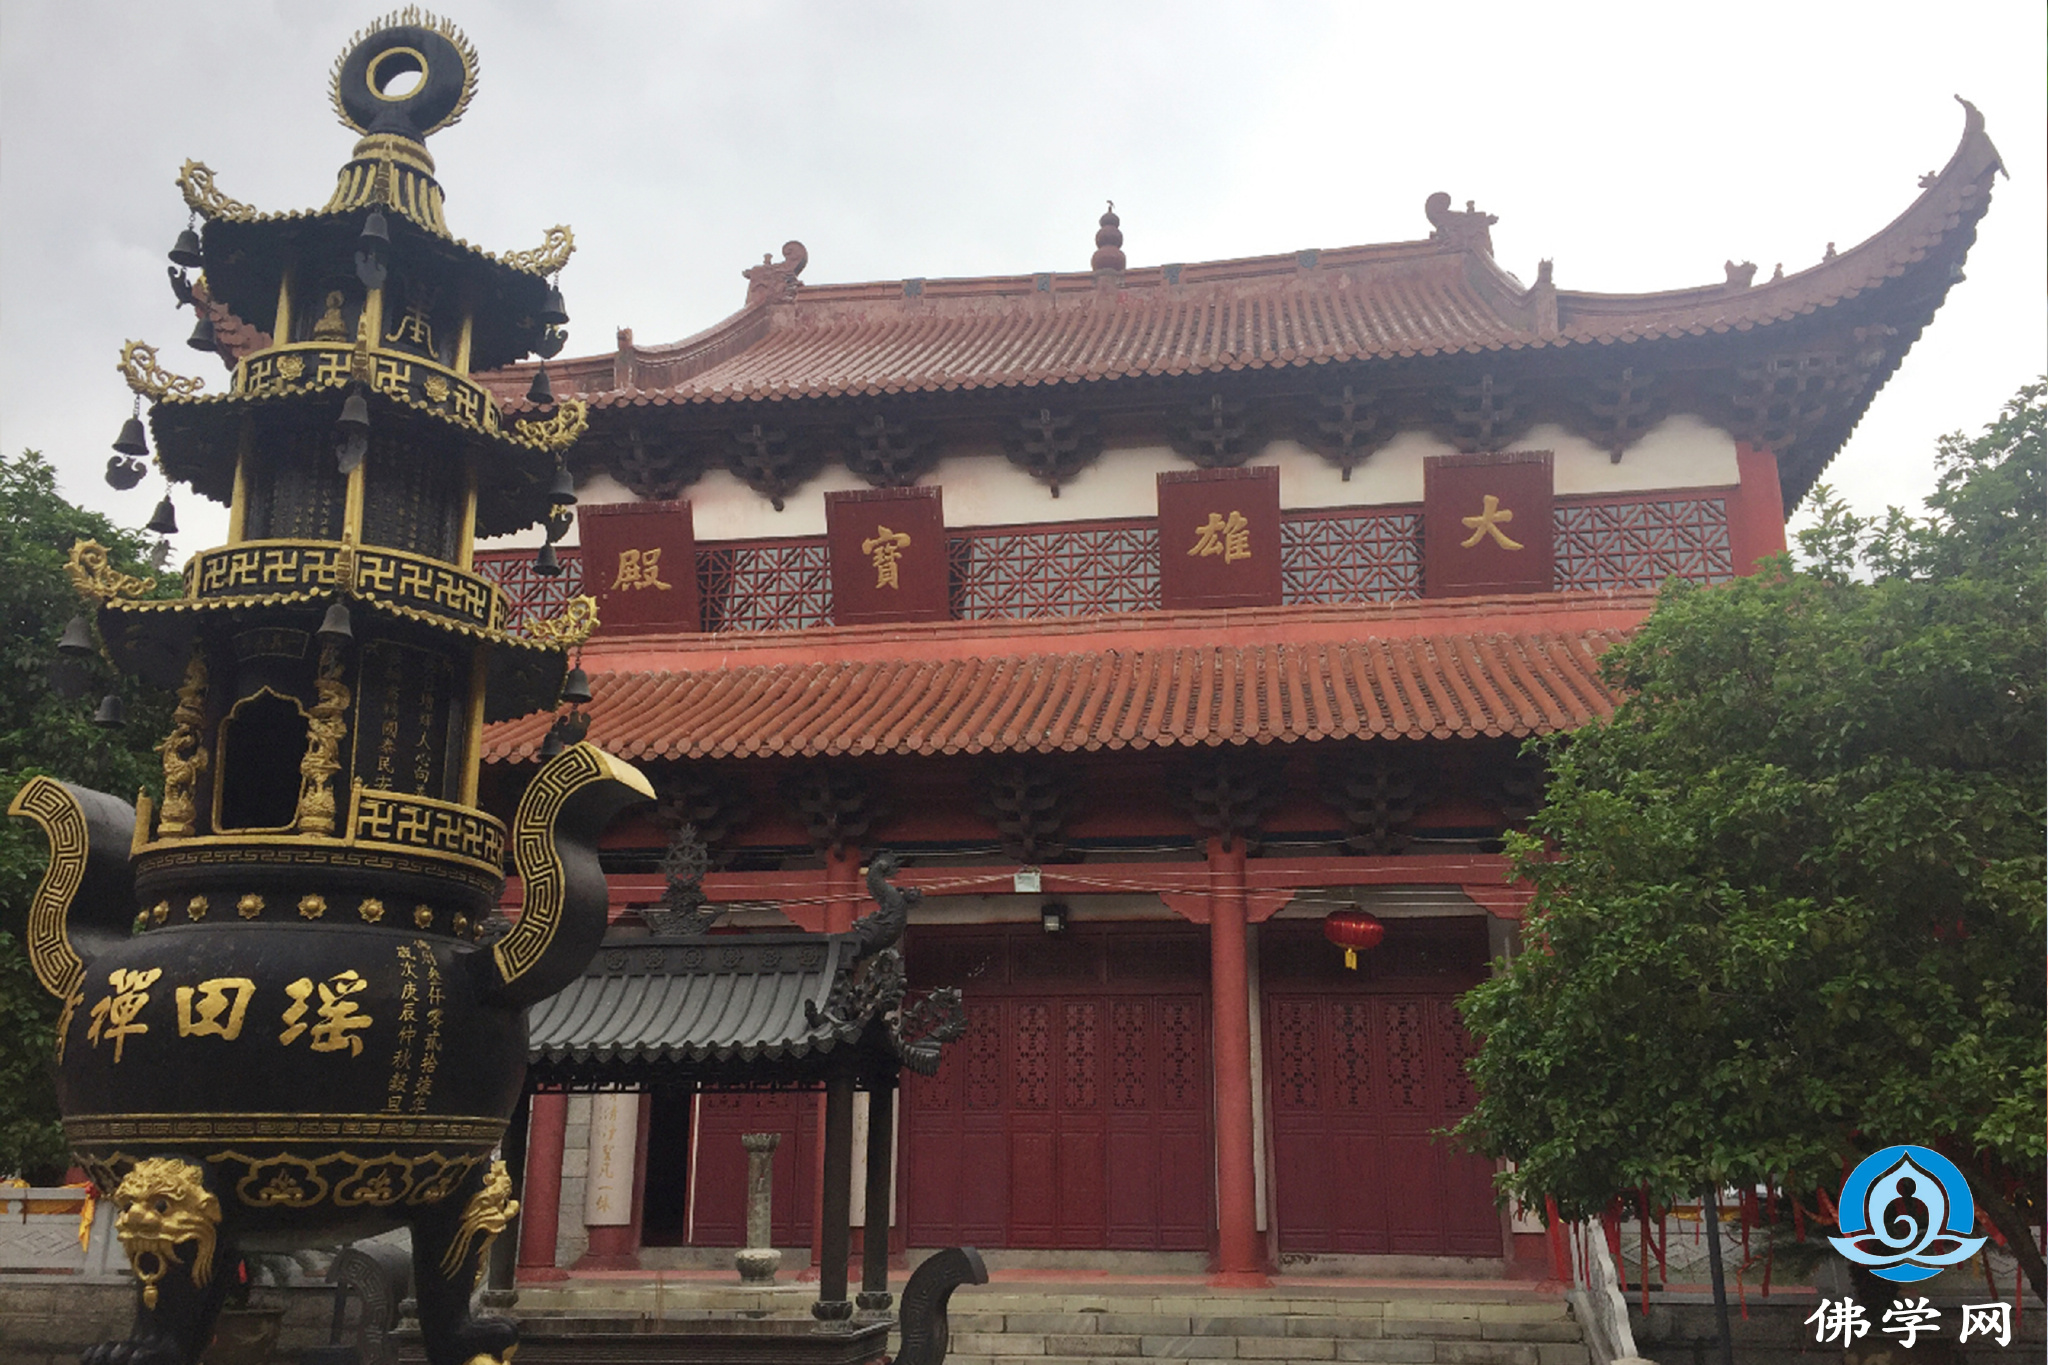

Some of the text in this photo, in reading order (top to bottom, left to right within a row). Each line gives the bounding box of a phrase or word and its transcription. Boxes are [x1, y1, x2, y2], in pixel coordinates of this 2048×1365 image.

[1187, 511, 1252, 564] 雄
[1461, 494, 1524, 551] 大
[611, 547, 672, 592] 殿
